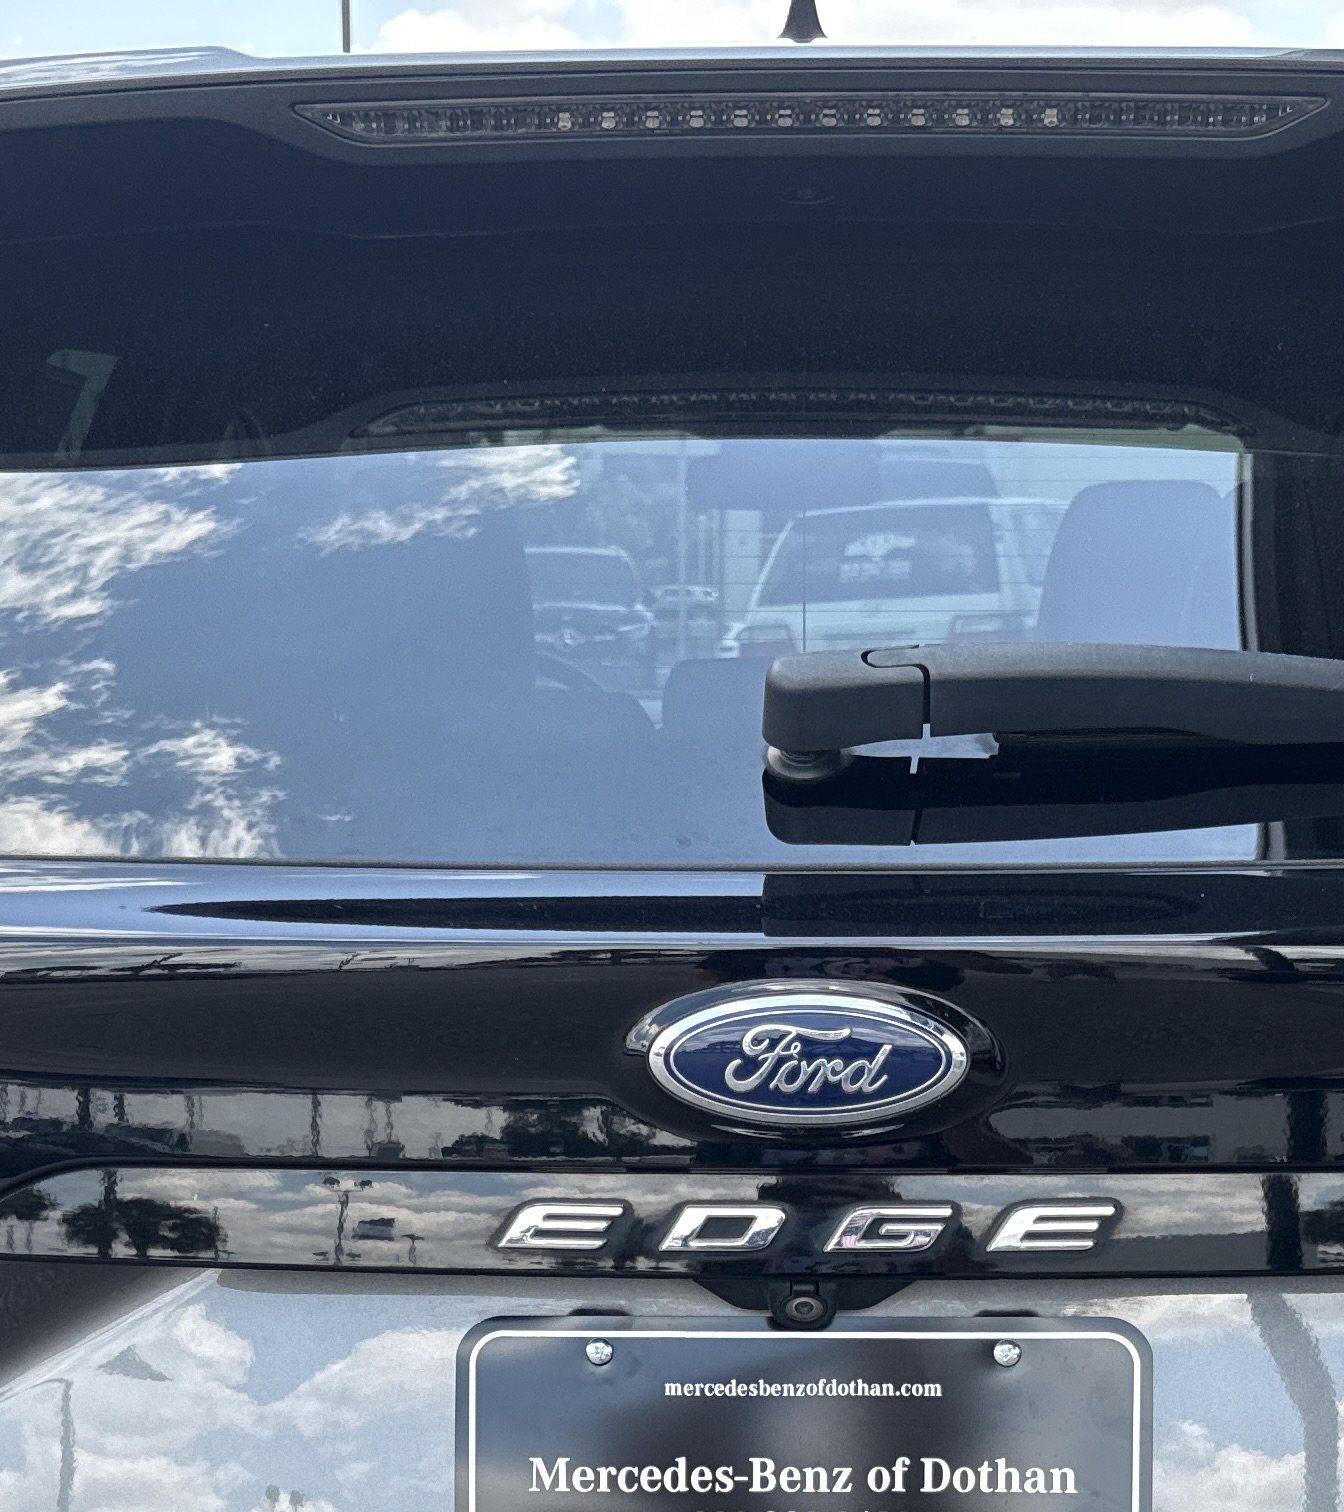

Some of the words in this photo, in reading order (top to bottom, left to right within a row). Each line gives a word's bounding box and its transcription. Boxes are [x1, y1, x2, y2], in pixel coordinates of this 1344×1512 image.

[724, 1023, 894, 1095] Ford
[497, 1204, 1117, 1253] EDGE
[664, 1378, 943, 1398] mercedesbenzofdothan.com
[528, 1456, 853, 1494] Mercedes-Benz
[867, 1456, 911, 1494] of
[919, 1457, 1079, 1495] Dothan
